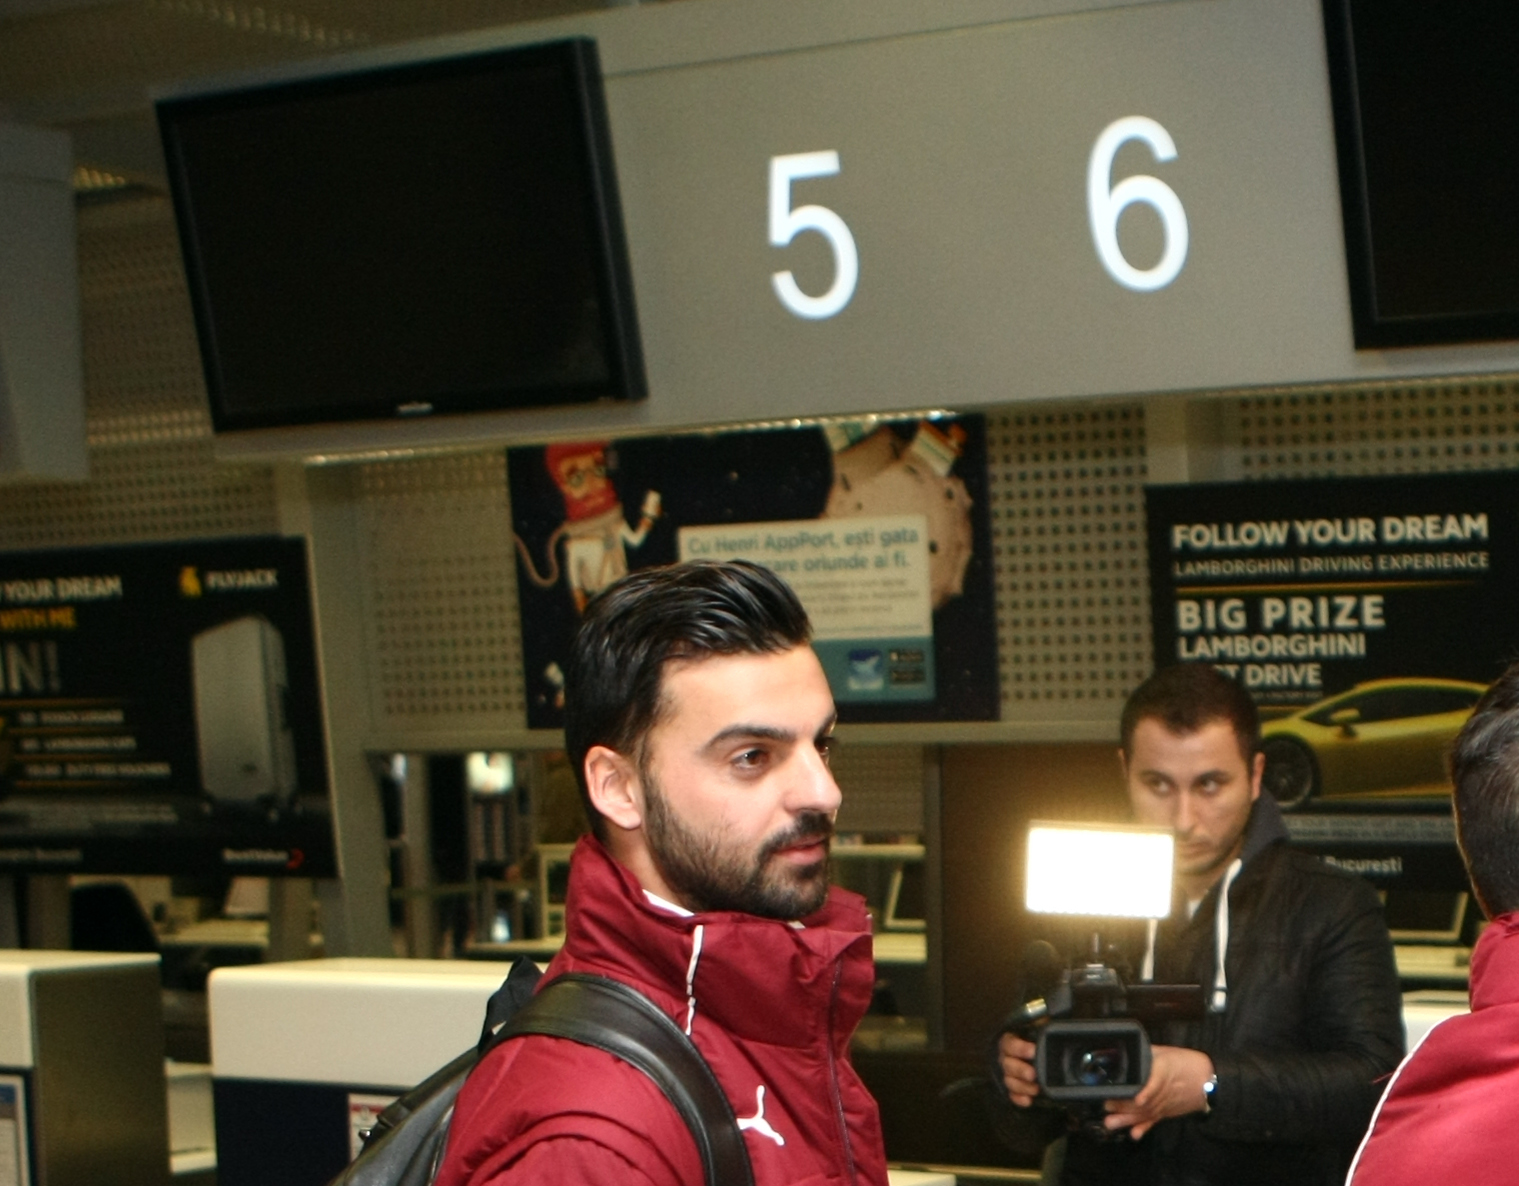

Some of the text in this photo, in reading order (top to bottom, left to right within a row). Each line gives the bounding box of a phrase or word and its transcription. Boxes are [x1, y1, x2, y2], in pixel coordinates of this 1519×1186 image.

[1087, 115, 1189, 292] 6
[768, 149, 859, 320] 5
[880, 527, 918, 547] gata
[1172, 512, 1488, 548] FOLLOW YOUR DREAM
[1175, 551, 1490, 577] LAMBORGHINI DRIVING EXPERIENCE
[1177, 595, 1385, 631] BIG PRIZE
[1179, 632, 1366, 659] LAMBORGHINI
[1245, 663, 1322, 686] DRIVE
